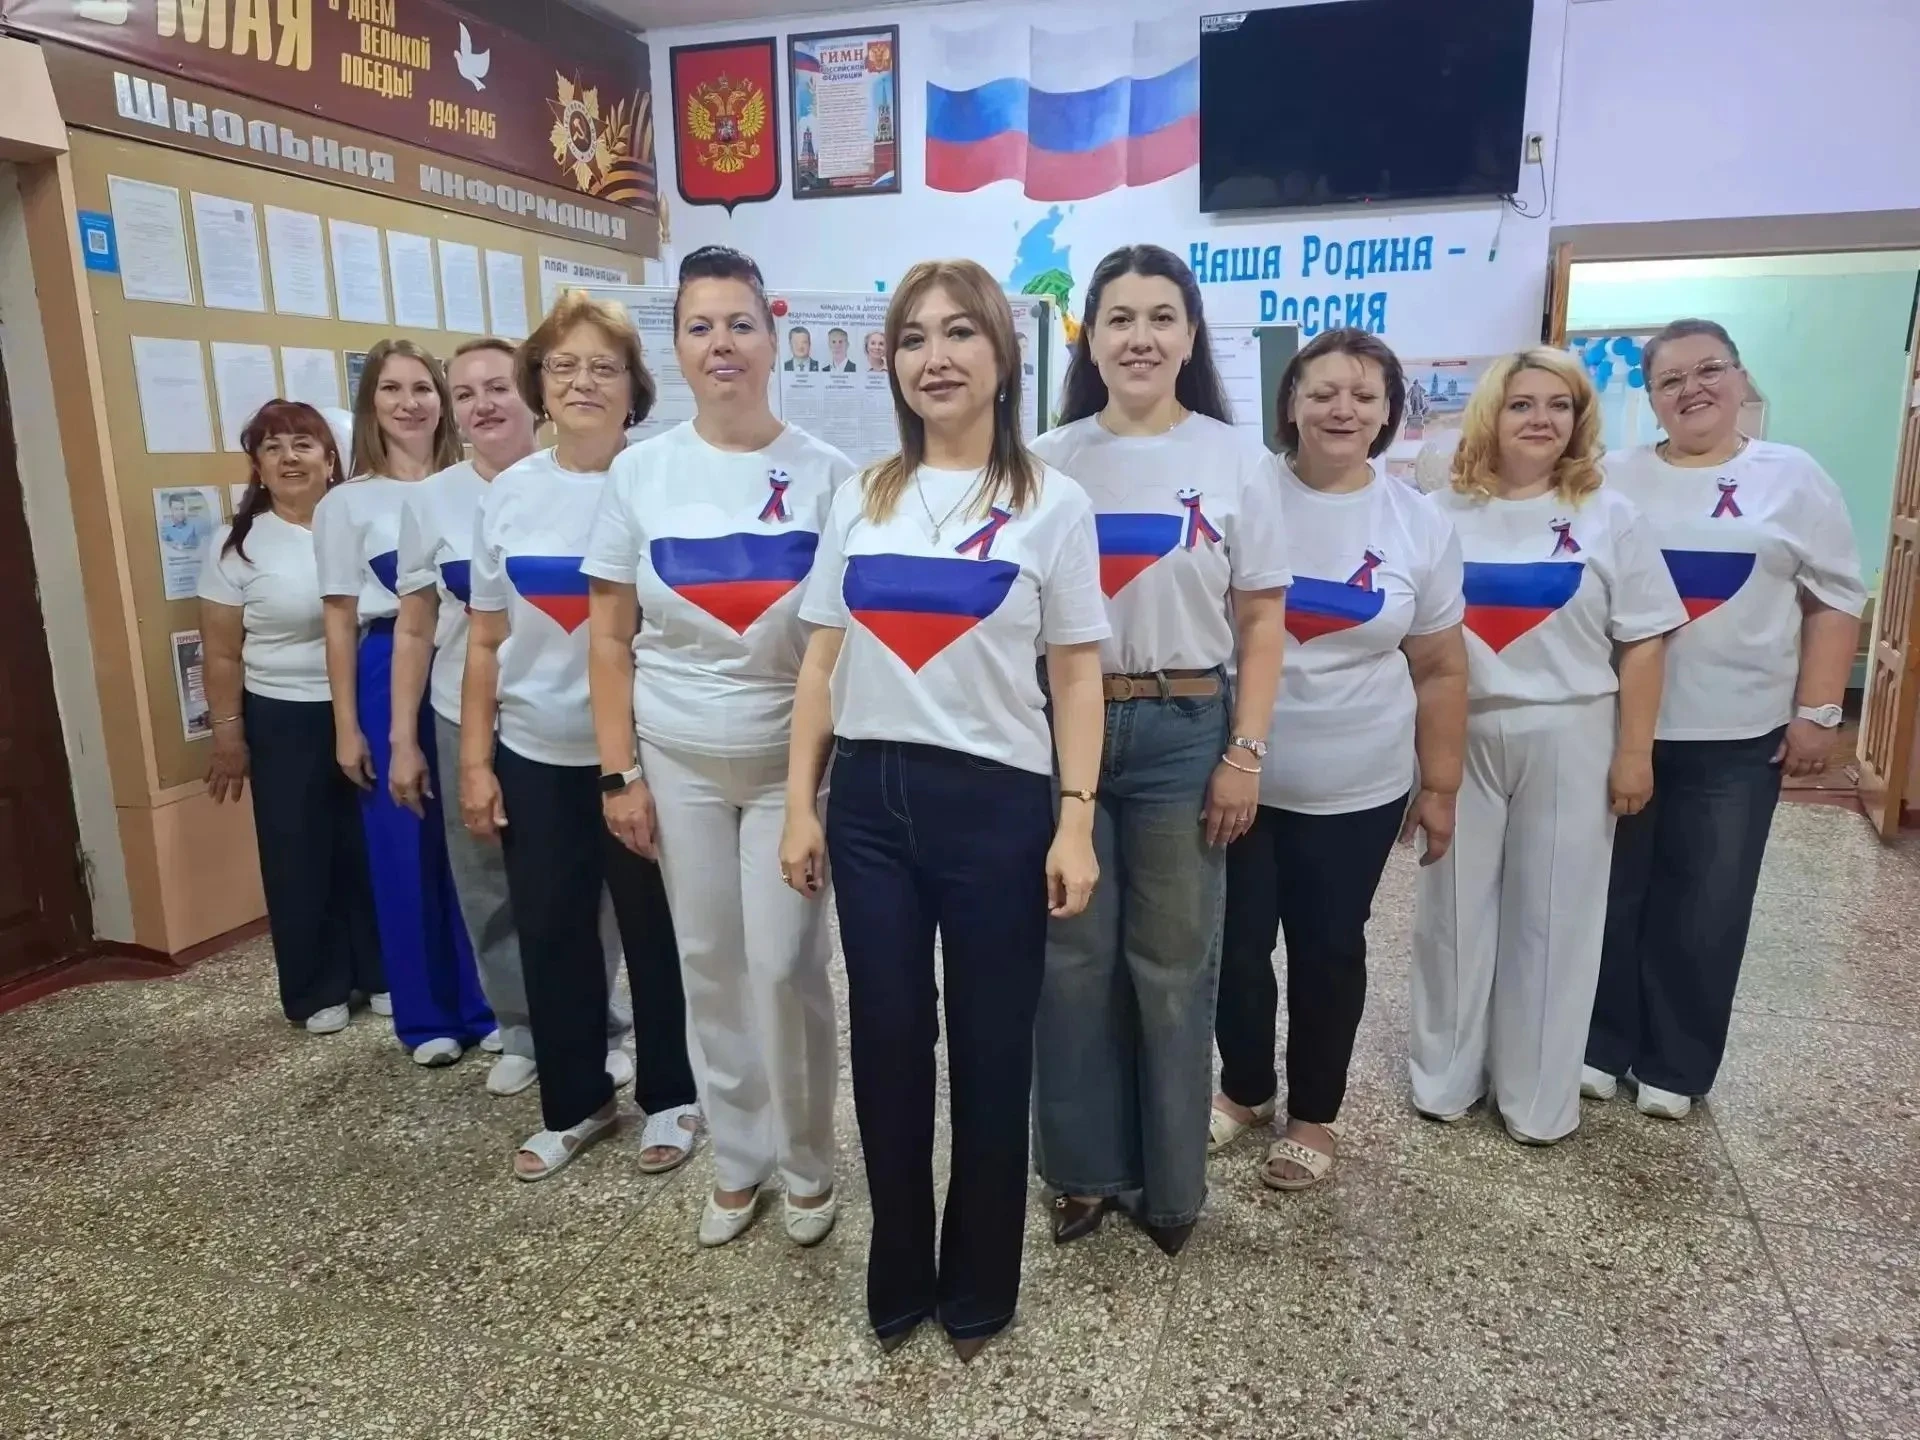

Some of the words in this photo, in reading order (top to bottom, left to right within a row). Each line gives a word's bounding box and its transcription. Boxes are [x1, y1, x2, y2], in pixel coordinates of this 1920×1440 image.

[157, 0, 312, 71] МАЯ
[360, 23, 431, 71] ВЕЛИКОЙ
[820, 48, 864, 64] ГИМН
[340, 52, 413, 99] ПОБЕДЫ!
[428, 98, 497, 140] 1941-1945
